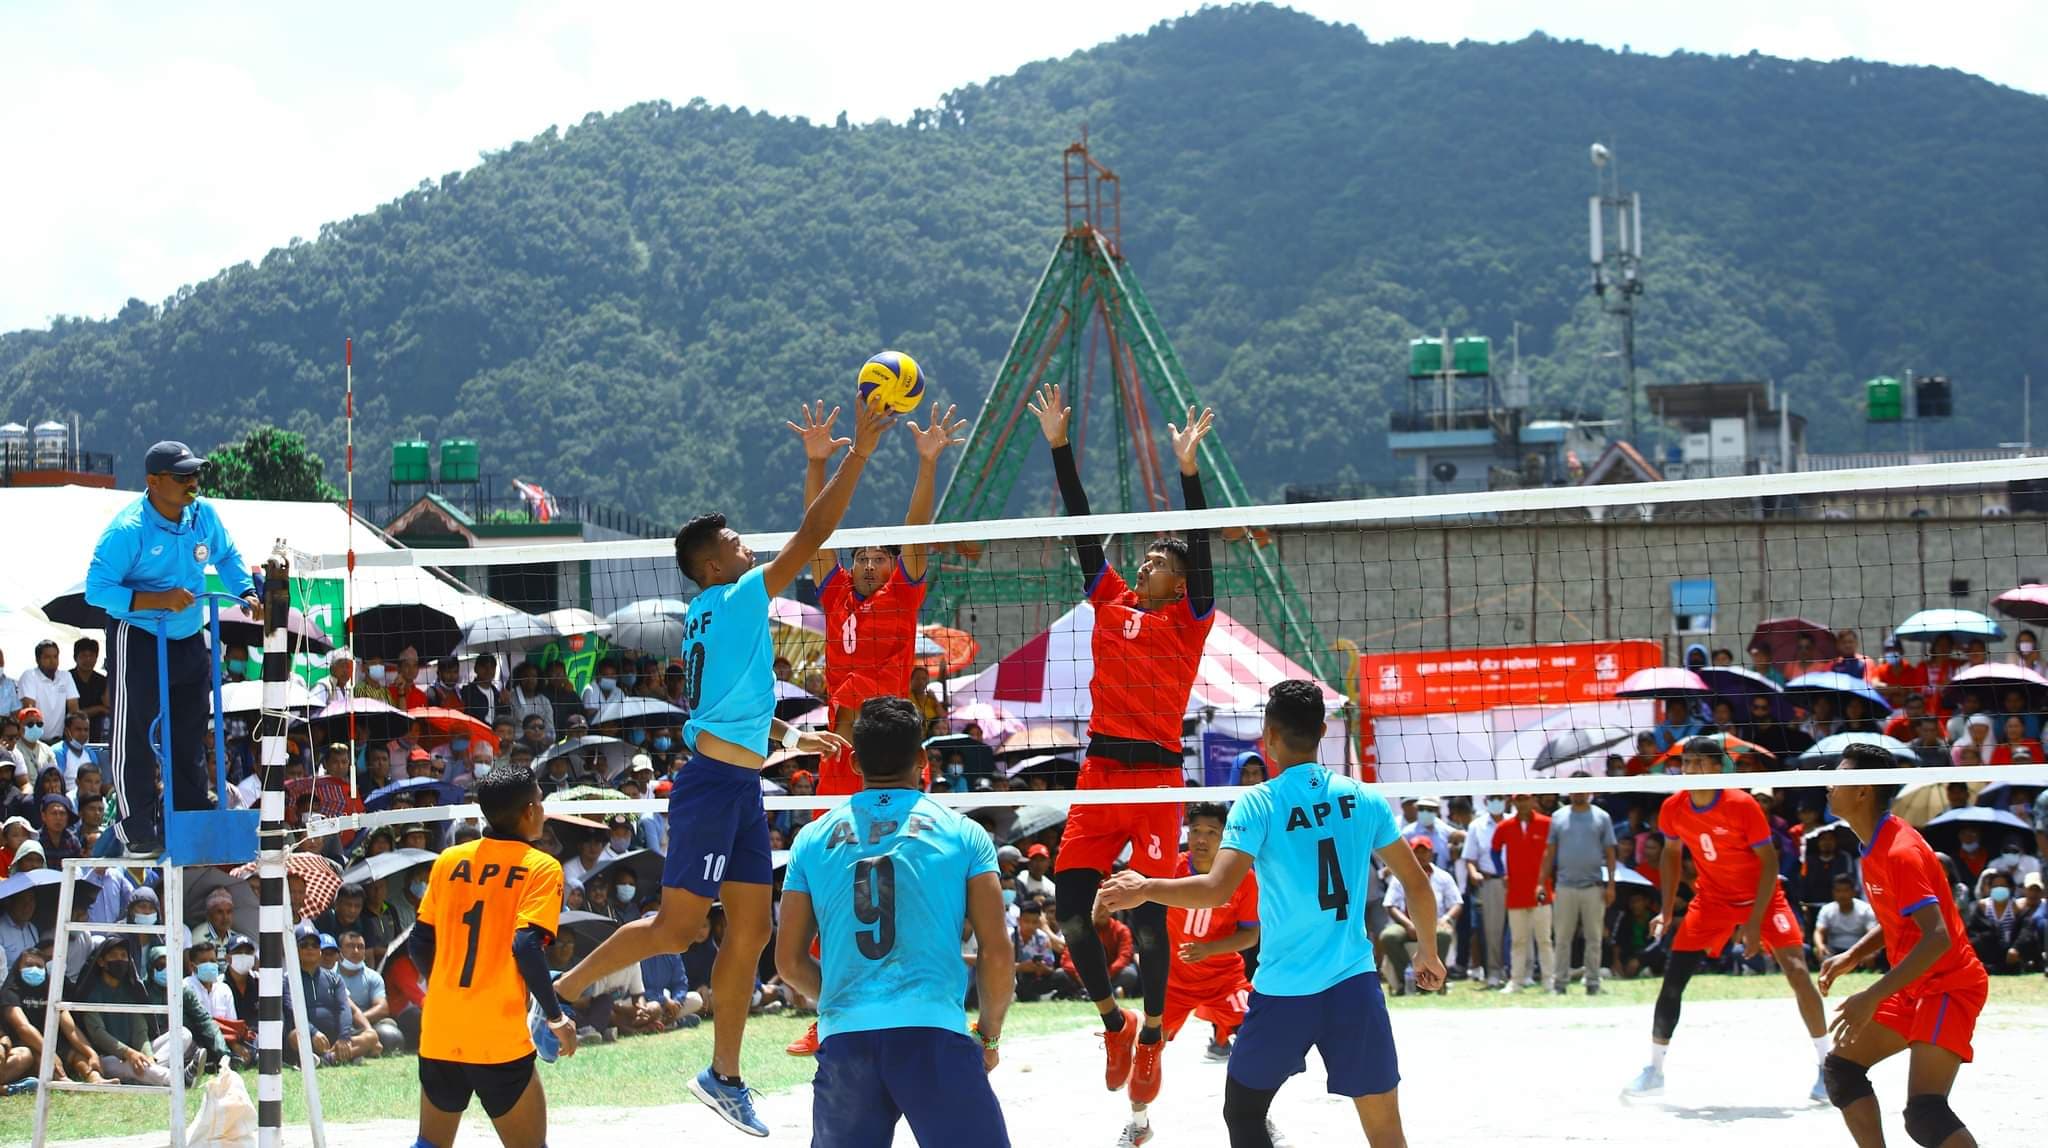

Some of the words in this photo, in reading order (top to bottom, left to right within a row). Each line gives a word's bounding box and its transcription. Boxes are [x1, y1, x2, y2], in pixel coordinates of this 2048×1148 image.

[842, 613, 857, 655] 8
[1123, 610, 1145, 640] 3
[1286, 795, 1357, 832] APF
[1148, 834, 1162, 860] 3
[1699, 832, 1717, 862] 9
[449, 860, 529, 888] APF
[703, 853, 726, 882] 10
[1317, 837, 1350, 922] 4
[854, 855, 896, 960] 9
[1183, 907, 1213, 938] 10
[459, 900, 484, 988] 1
[1226, 989, 1250, 1012] 10
